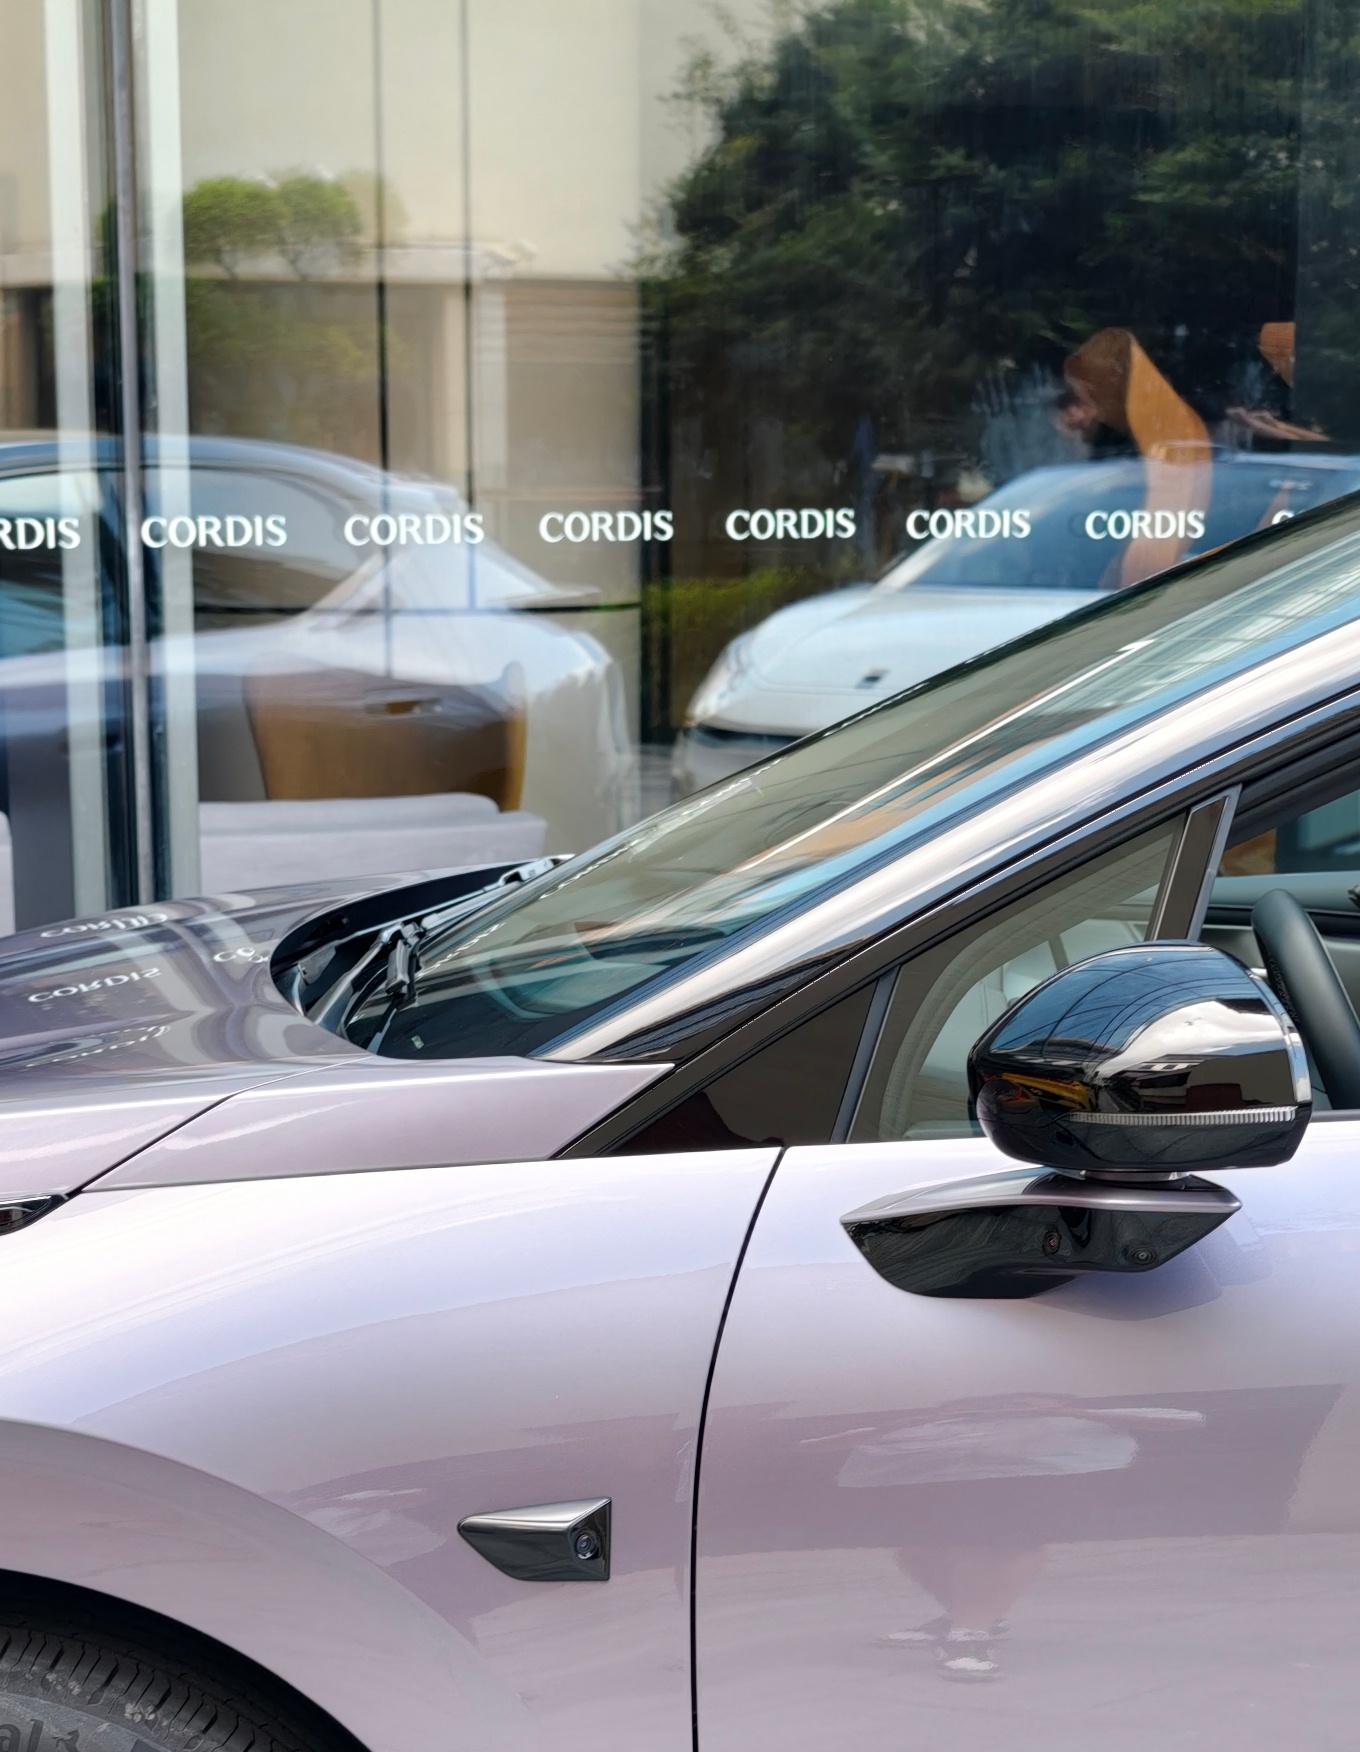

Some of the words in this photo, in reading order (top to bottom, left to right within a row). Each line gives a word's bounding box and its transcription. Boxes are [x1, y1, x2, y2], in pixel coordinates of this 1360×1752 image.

[140, 514, 287, 548] CORDIS
[344, 513, 485, 546] CORDIS
[538, 510, 674, 543] CORDIS
[725, 508, 857, 541] CORDIS
[905, 509, 1032, 541] CORDIS
[1084, 510, 1206, 540] CORDIS
